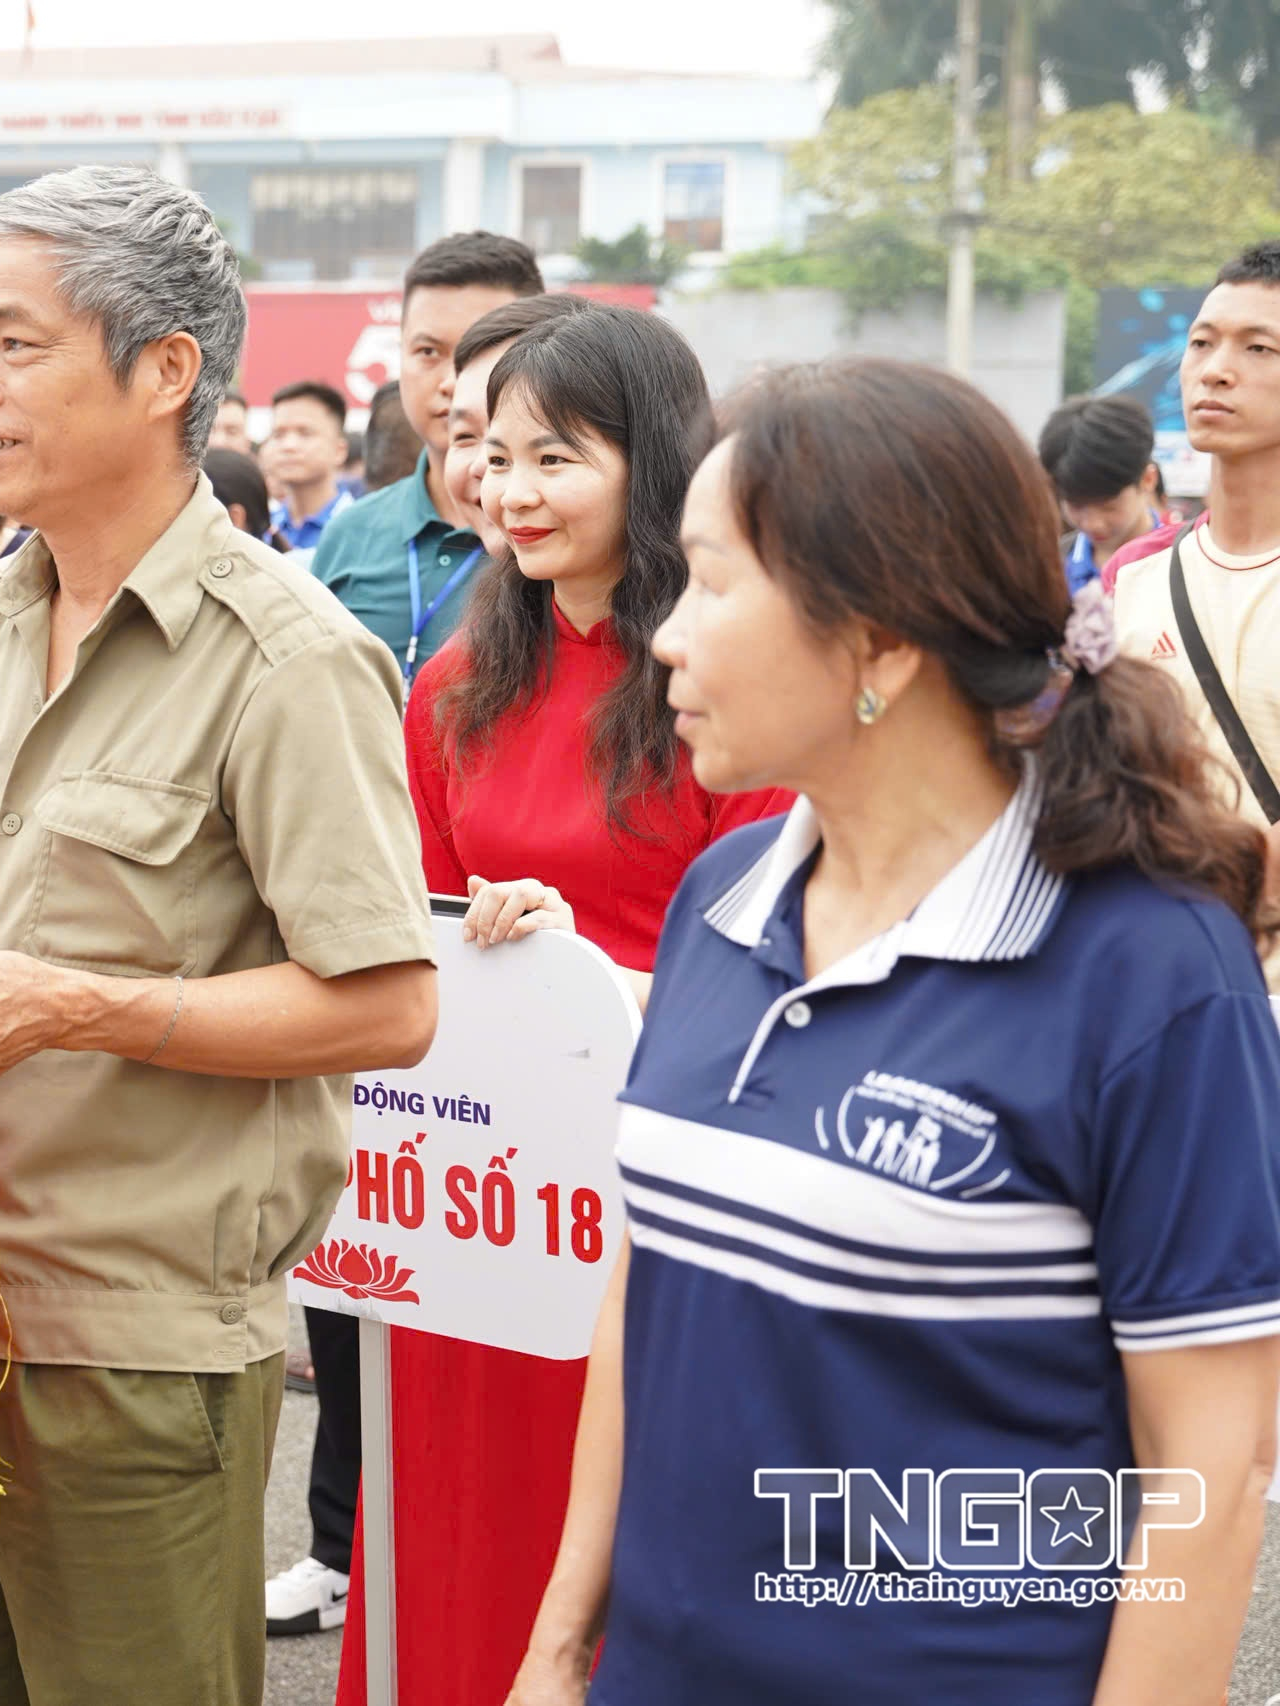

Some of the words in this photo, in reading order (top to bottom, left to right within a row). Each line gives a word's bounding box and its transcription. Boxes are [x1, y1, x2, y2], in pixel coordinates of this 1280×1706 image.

[353, 1081, 425, 1116] ĐỘNG
[432, 1094, 492, 1126] VIÊN
[344, 1132, 428, 1231] HỐ
[444, 1147, 519, 1248] SỐ
[536, 1182, 604, 1264] 18
